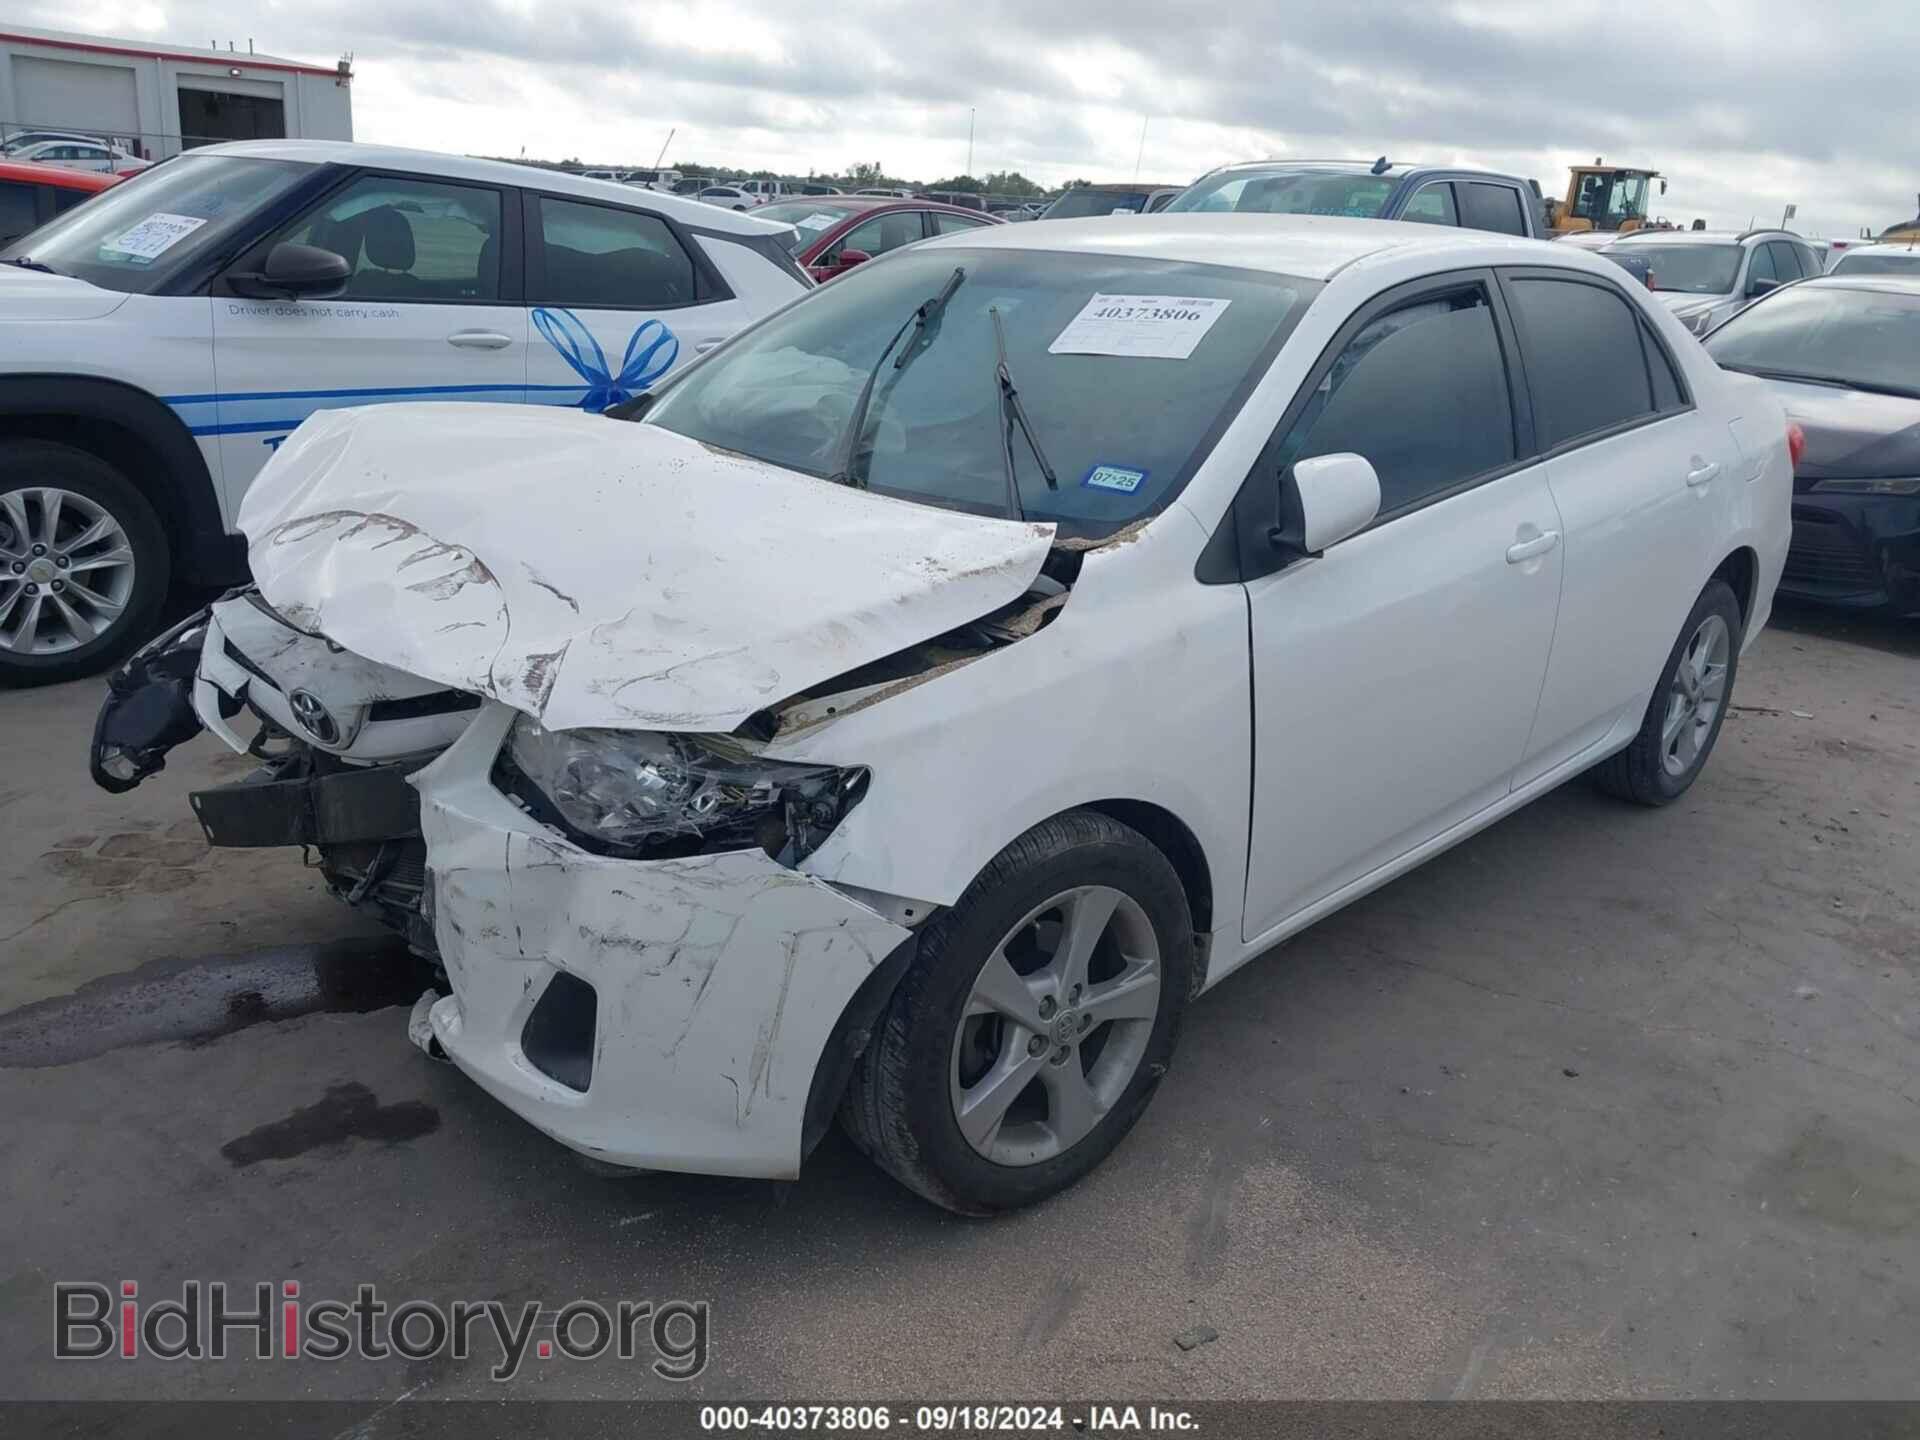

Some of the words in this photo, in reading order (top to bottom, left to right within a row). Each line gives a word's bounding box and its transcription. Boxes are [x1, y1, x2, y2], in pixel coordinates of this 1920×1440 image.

[228, 304, 270, 316] Driver
[274, 305, 307, 317] does
[311, 307, 333, 317] not
[336, 308, 368, 319] carry
[371, 308, 400, 319] cash
[1093, 307, 1201, 321] 40373806
